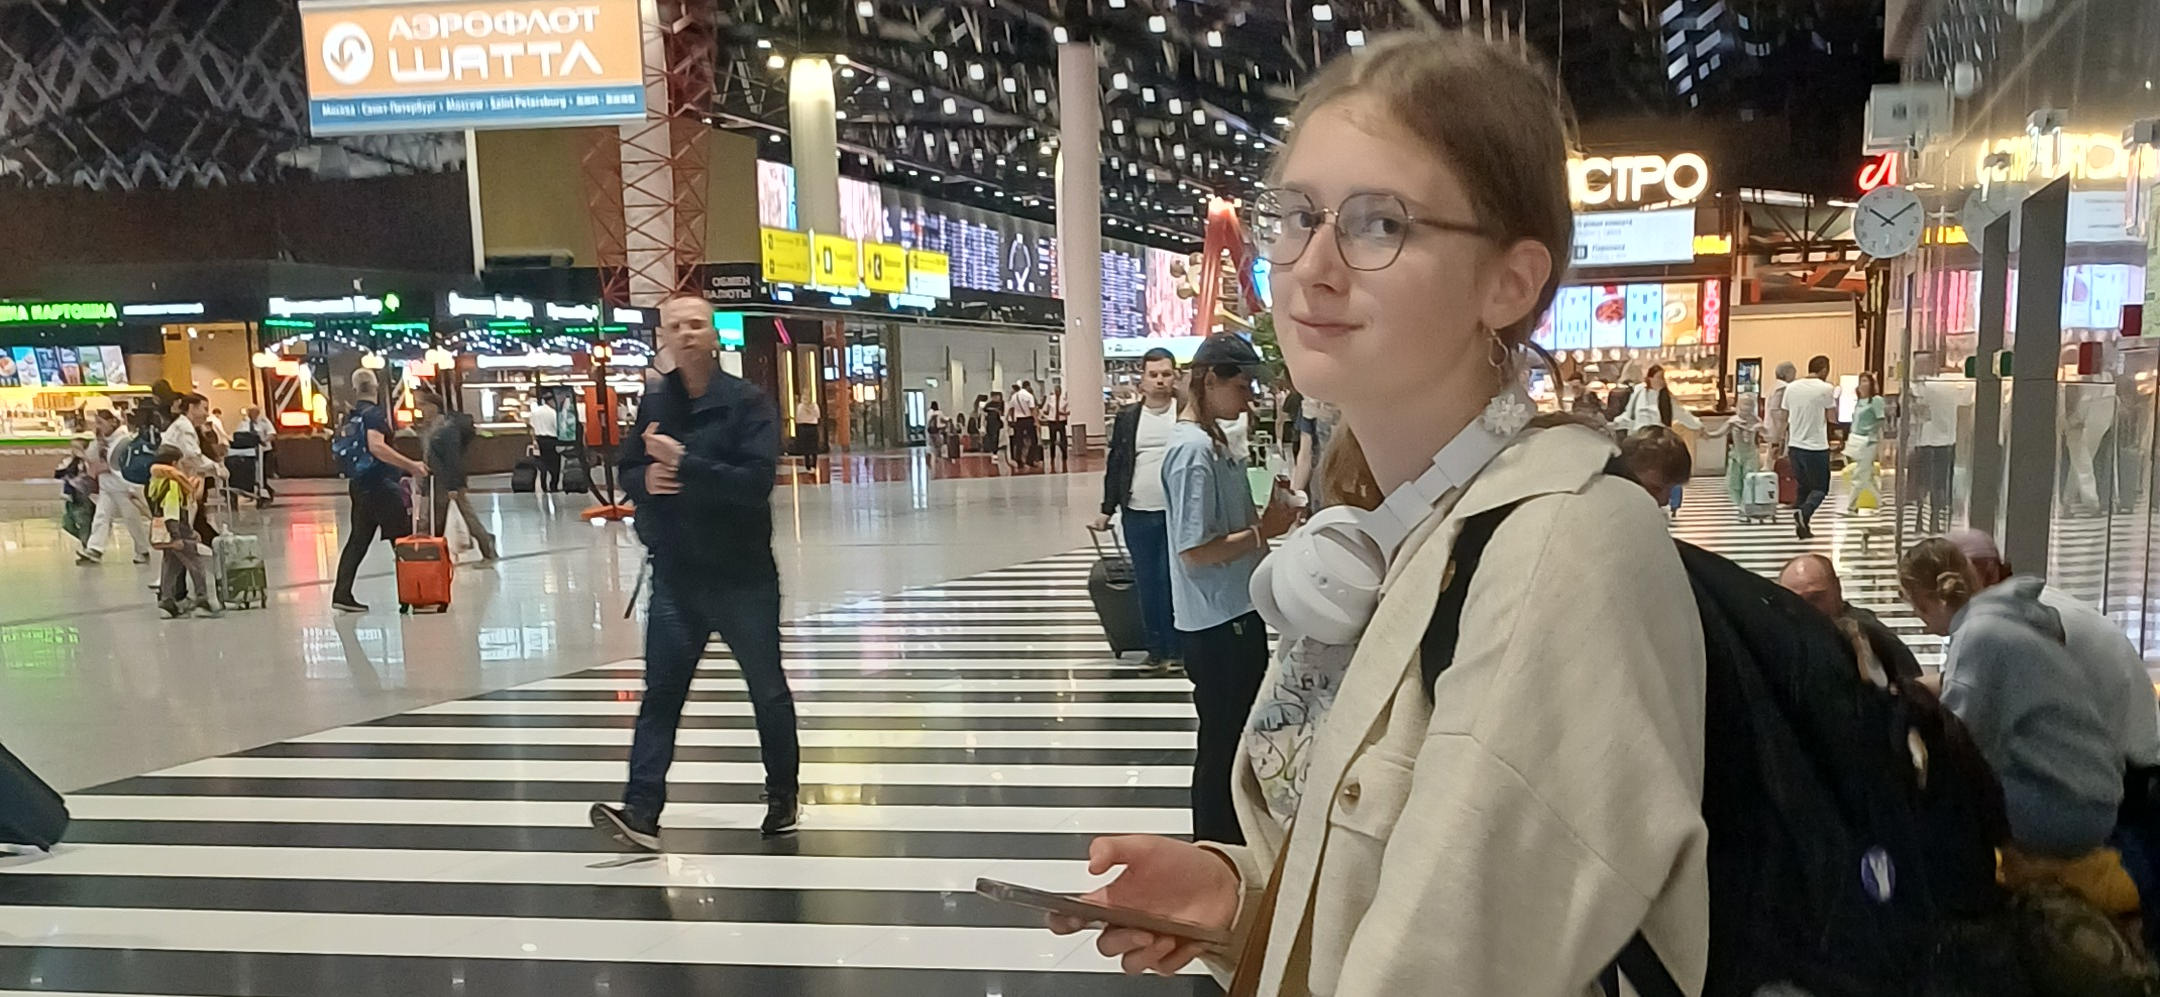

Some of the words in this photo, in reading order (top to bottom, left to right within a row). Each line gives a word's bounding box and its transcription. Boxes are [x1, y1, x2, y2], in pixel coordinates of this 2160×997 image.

[388, 6, 600, 40] АЭРОФЛОТ
[388, 40, 604, 83] ШАТТЛ
[702, 288, 752, 299] ВАЛЮТЫ
[711, 276, 751, 287] ОБМЕН
[31, 303, 117, 320] КАРТОШКА
[1704, 280, 1720, 343] КОФЕ
